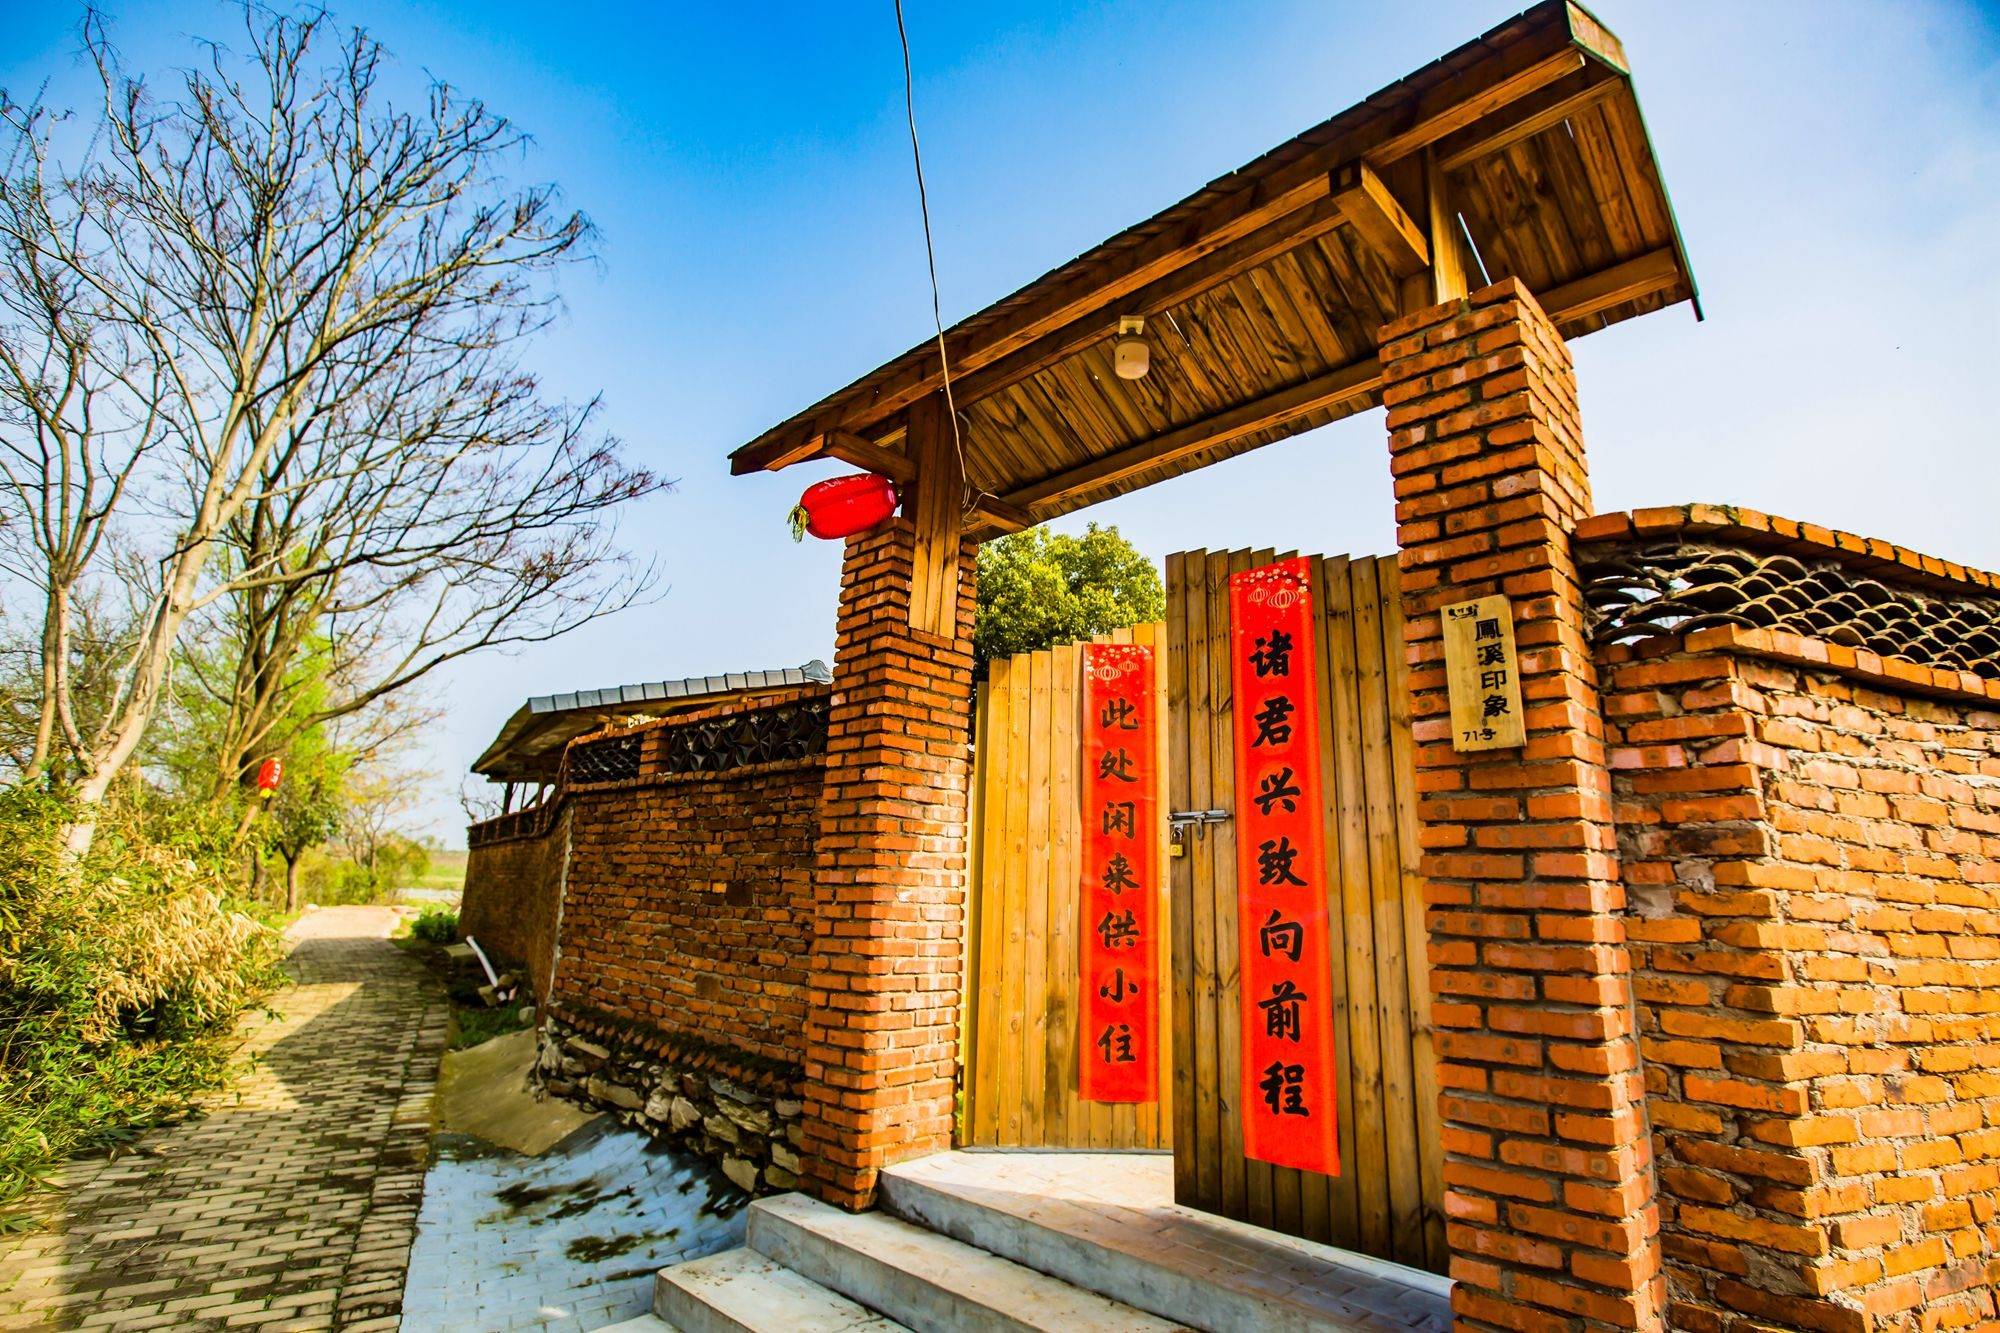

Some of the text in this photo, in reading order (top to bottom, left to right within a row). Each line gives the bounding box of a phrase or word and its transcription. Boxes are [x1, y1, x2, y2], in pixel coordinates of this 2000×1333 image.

[1097, 697, 1140, 1063] 此处闲来供小住
[1249, 629, 1309, 1117] 诸君兴致向前程
[1462, 728, 1496, 742] 71号
